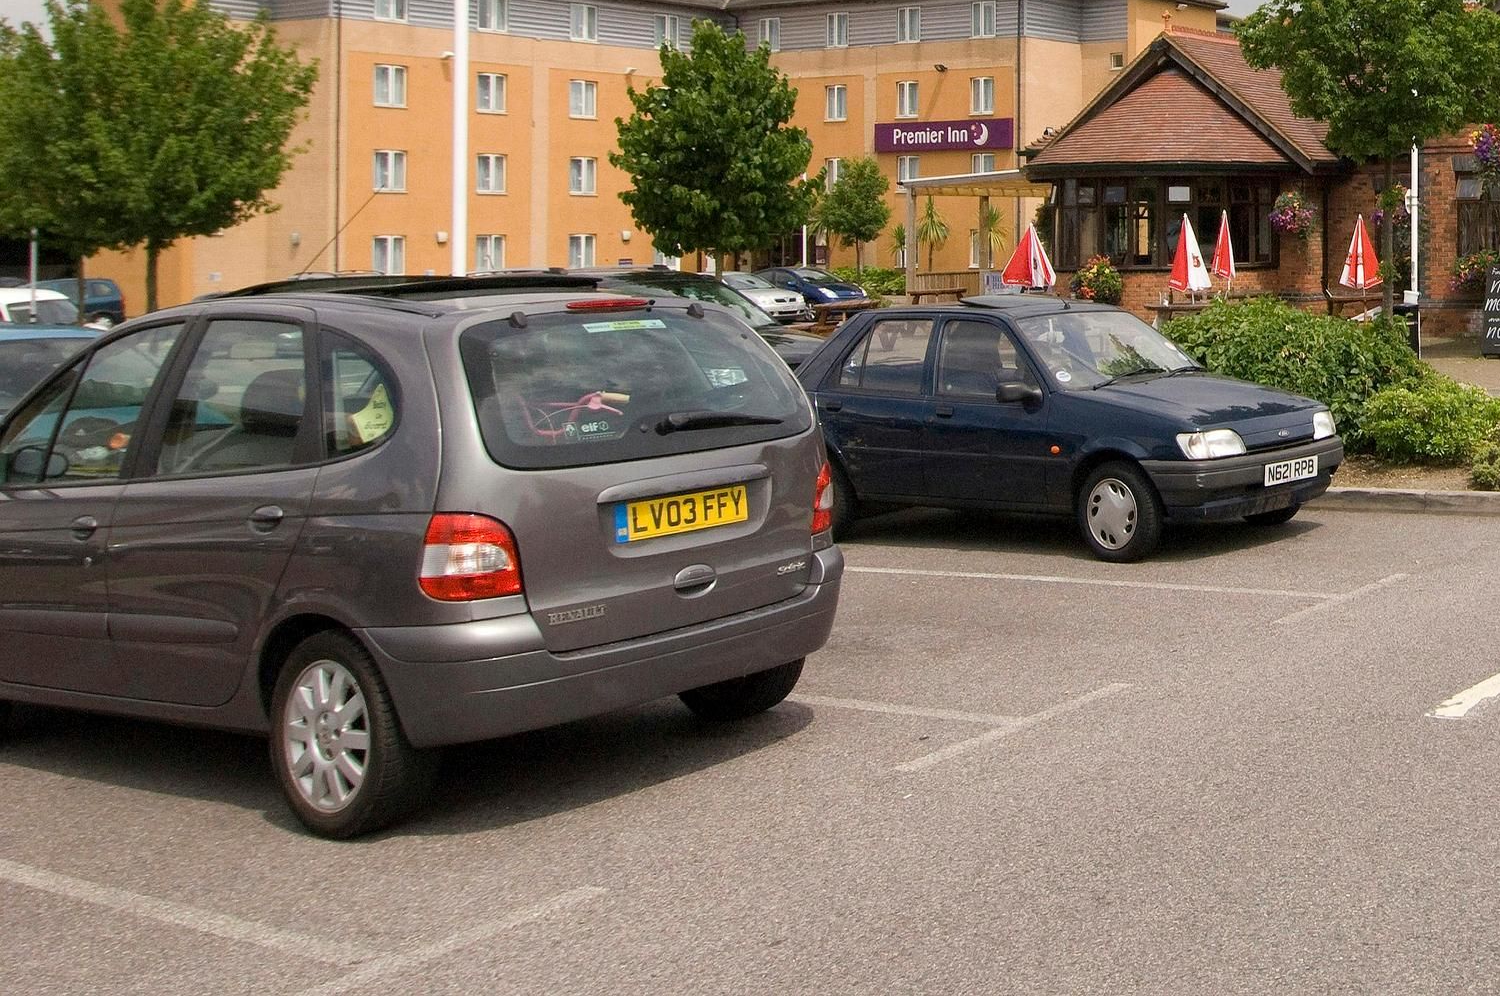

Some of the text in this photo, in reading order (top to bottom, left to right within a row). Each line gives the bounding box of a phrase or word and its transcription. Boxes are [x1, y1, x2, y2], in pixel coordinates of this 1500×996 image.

[893, 126, 968, 145] Premier Inn
[581, 422, 599, 434] elf
[1268, 459, 1314, 483] N621 RPB
[632, 489, 742, 534] LV03 FFY
[547, 603, 608, 626] RENAULT
